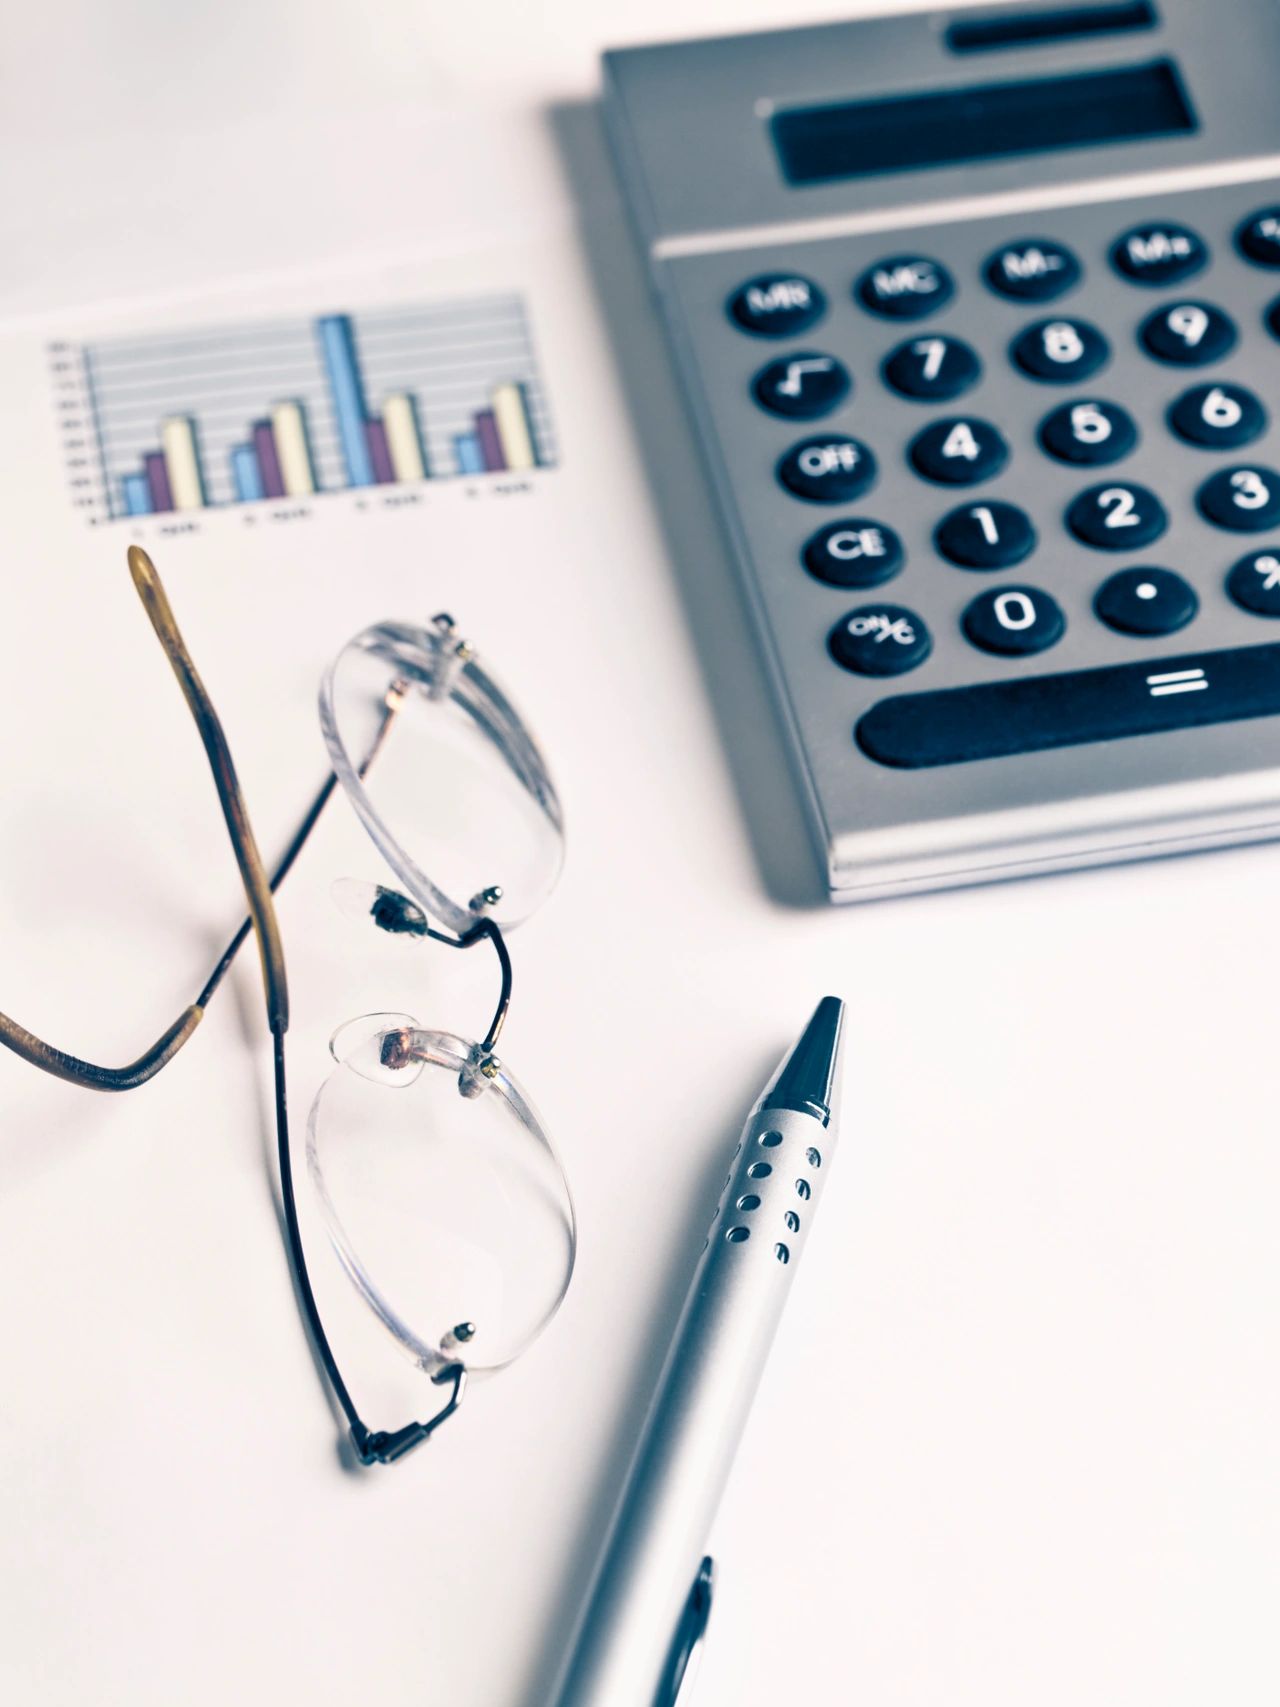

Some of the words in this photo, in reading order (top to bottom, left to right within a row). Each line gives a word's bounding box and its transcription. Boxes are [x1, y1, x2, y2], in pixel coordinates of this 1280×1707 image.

[746, 280, 811, 312] MR
[872, 263, 941, 296] MC
[1041, 321, 1085, 364] 8
[1166, 305, 1210, 347] 9
[911, 338, 947, 381] 7
[1070, 403, 1113, 445] 5
[1200, 387, 1243, 429] 6
[797, 442, 860, 478] OFF
[941, 421, 981, 462] 4
[1096, 486, 1142, 530] 2
[1229, 469, 1271, 511] 3
[826, 527, 886, 561] CE
[971, 506, 1000, 546] 1
[992, 590, 1038, 632] 0
